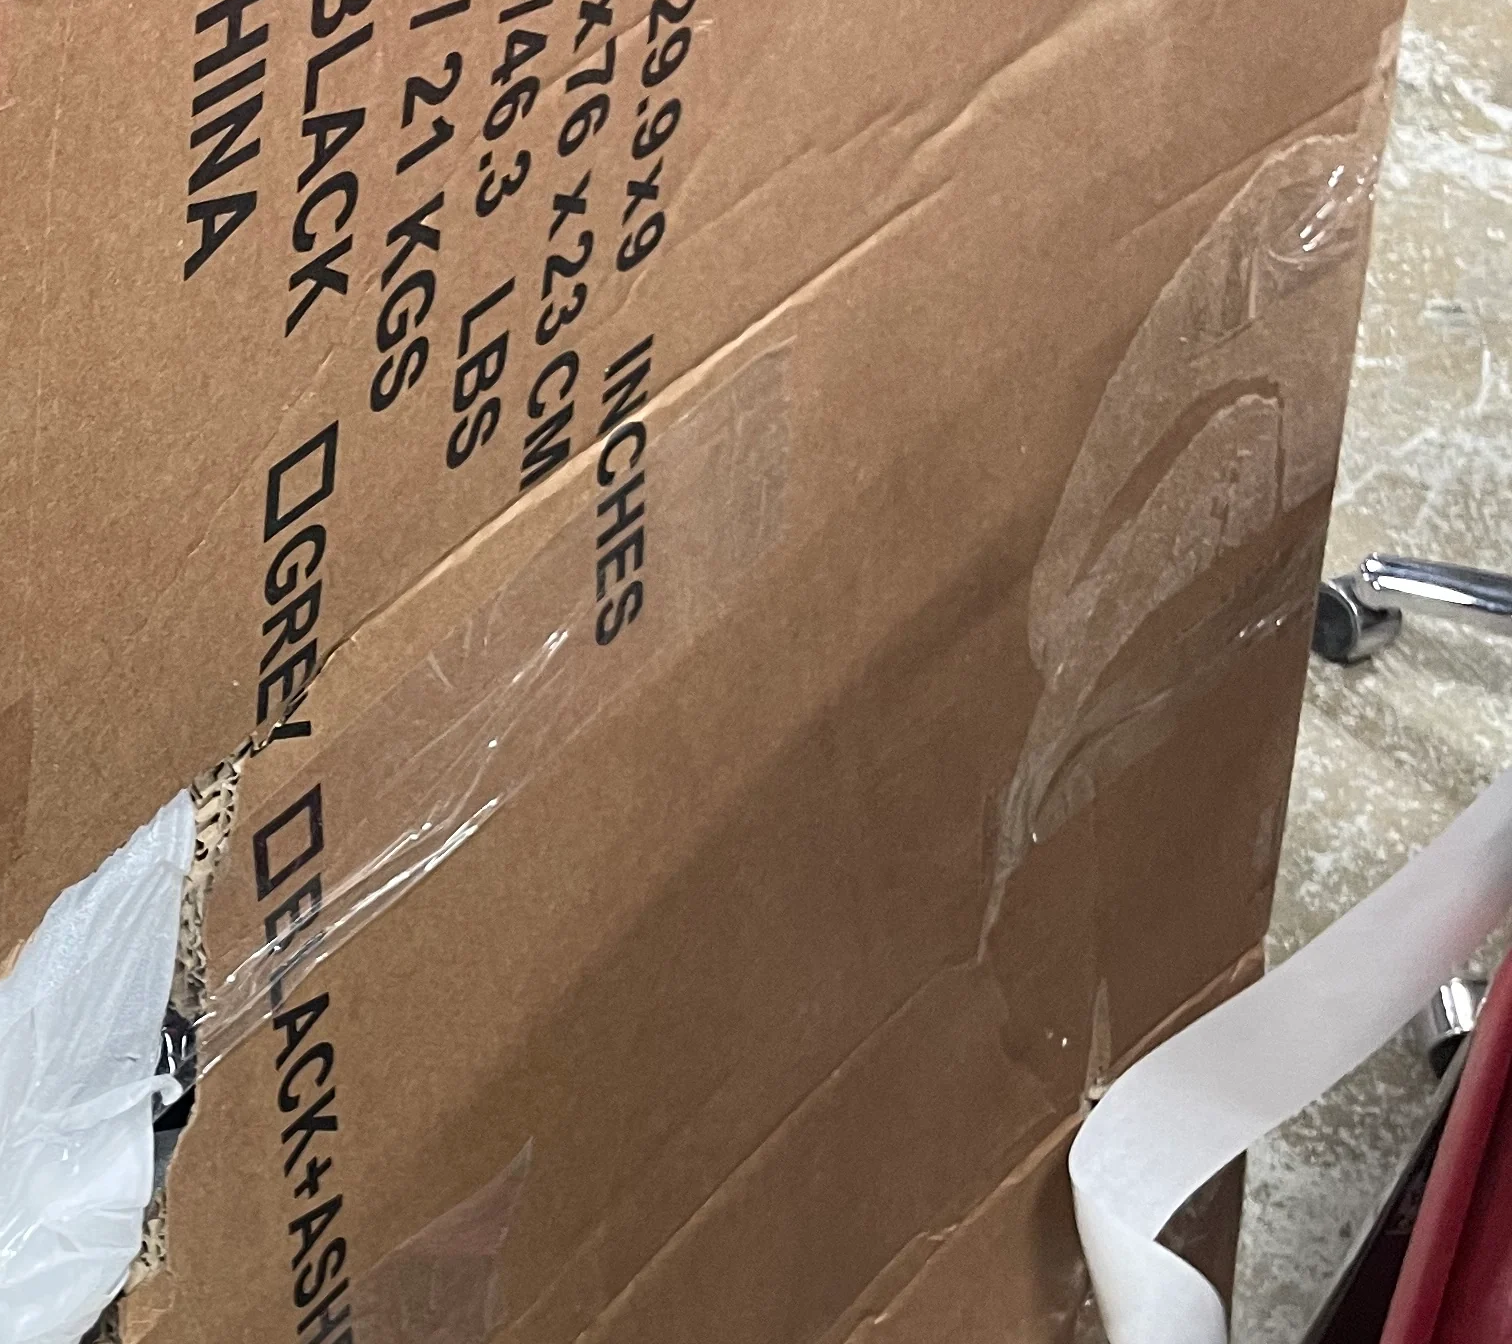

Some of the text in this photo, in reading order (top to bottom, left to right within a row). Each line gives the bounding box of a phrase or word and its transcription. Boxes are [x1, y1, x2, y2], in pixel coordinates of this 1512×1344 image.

[395, 52, 464, 175] 21
[369, 190, 446, 414] KGS
[445, 276, 516, 471] LBS
[594, 333, 654, 648] INCHES
